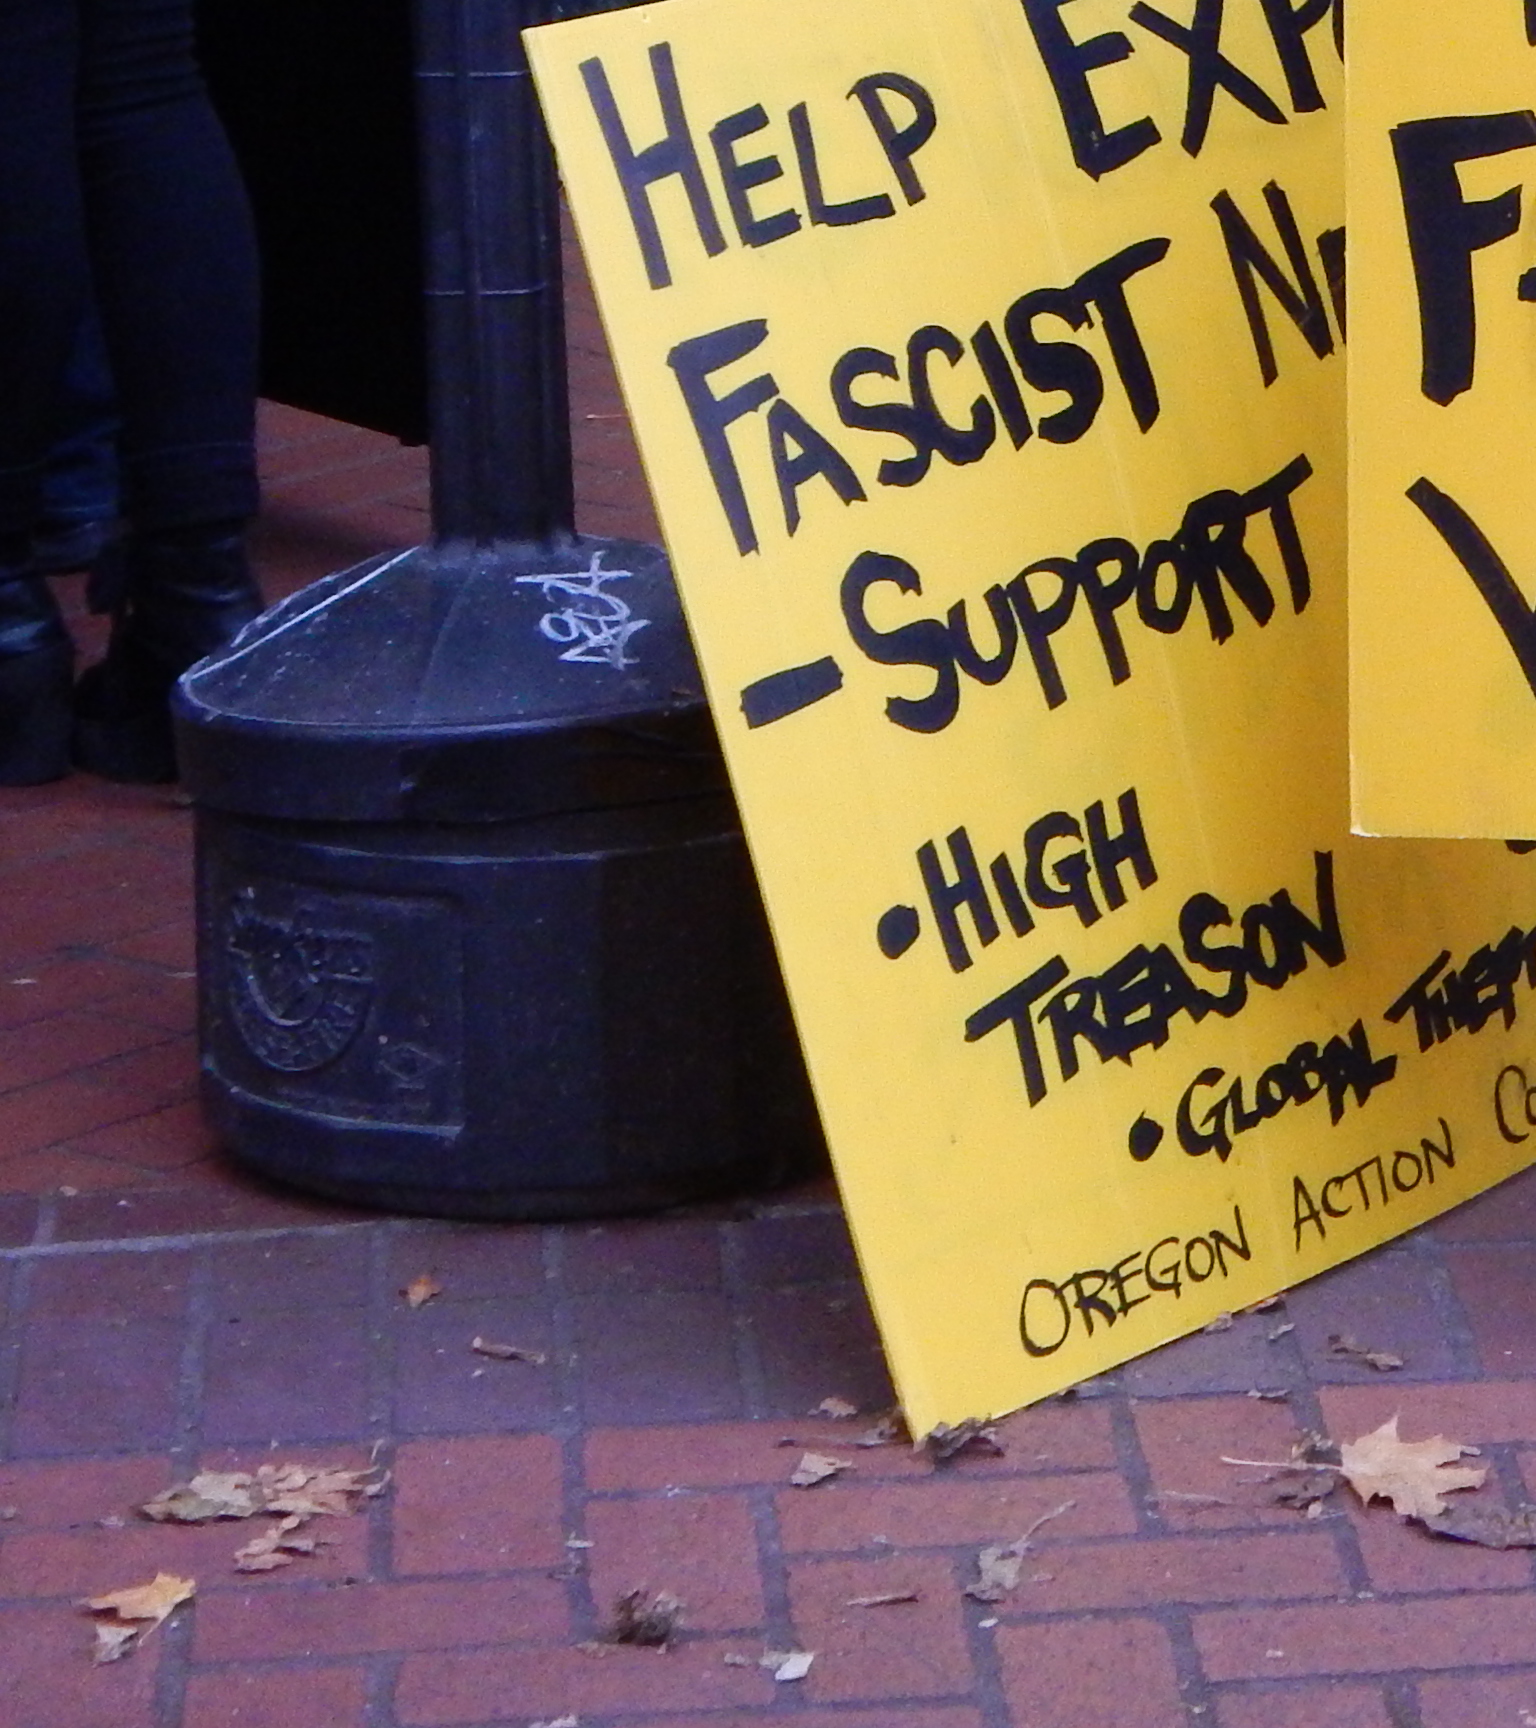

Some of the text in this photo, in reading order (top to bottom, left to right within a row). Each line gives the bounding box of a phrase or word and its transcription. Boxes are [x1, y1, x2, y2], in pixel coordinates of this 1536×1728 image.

[580, 42, 936, 288] HELP
[667, 238, 1171, 556] FASCIST
[965, 850, 1347, 1107] TREASON
[1021, 1205, 1251, 1357] OREGON
[1293, 1117, 1457, 1239] ACTION
